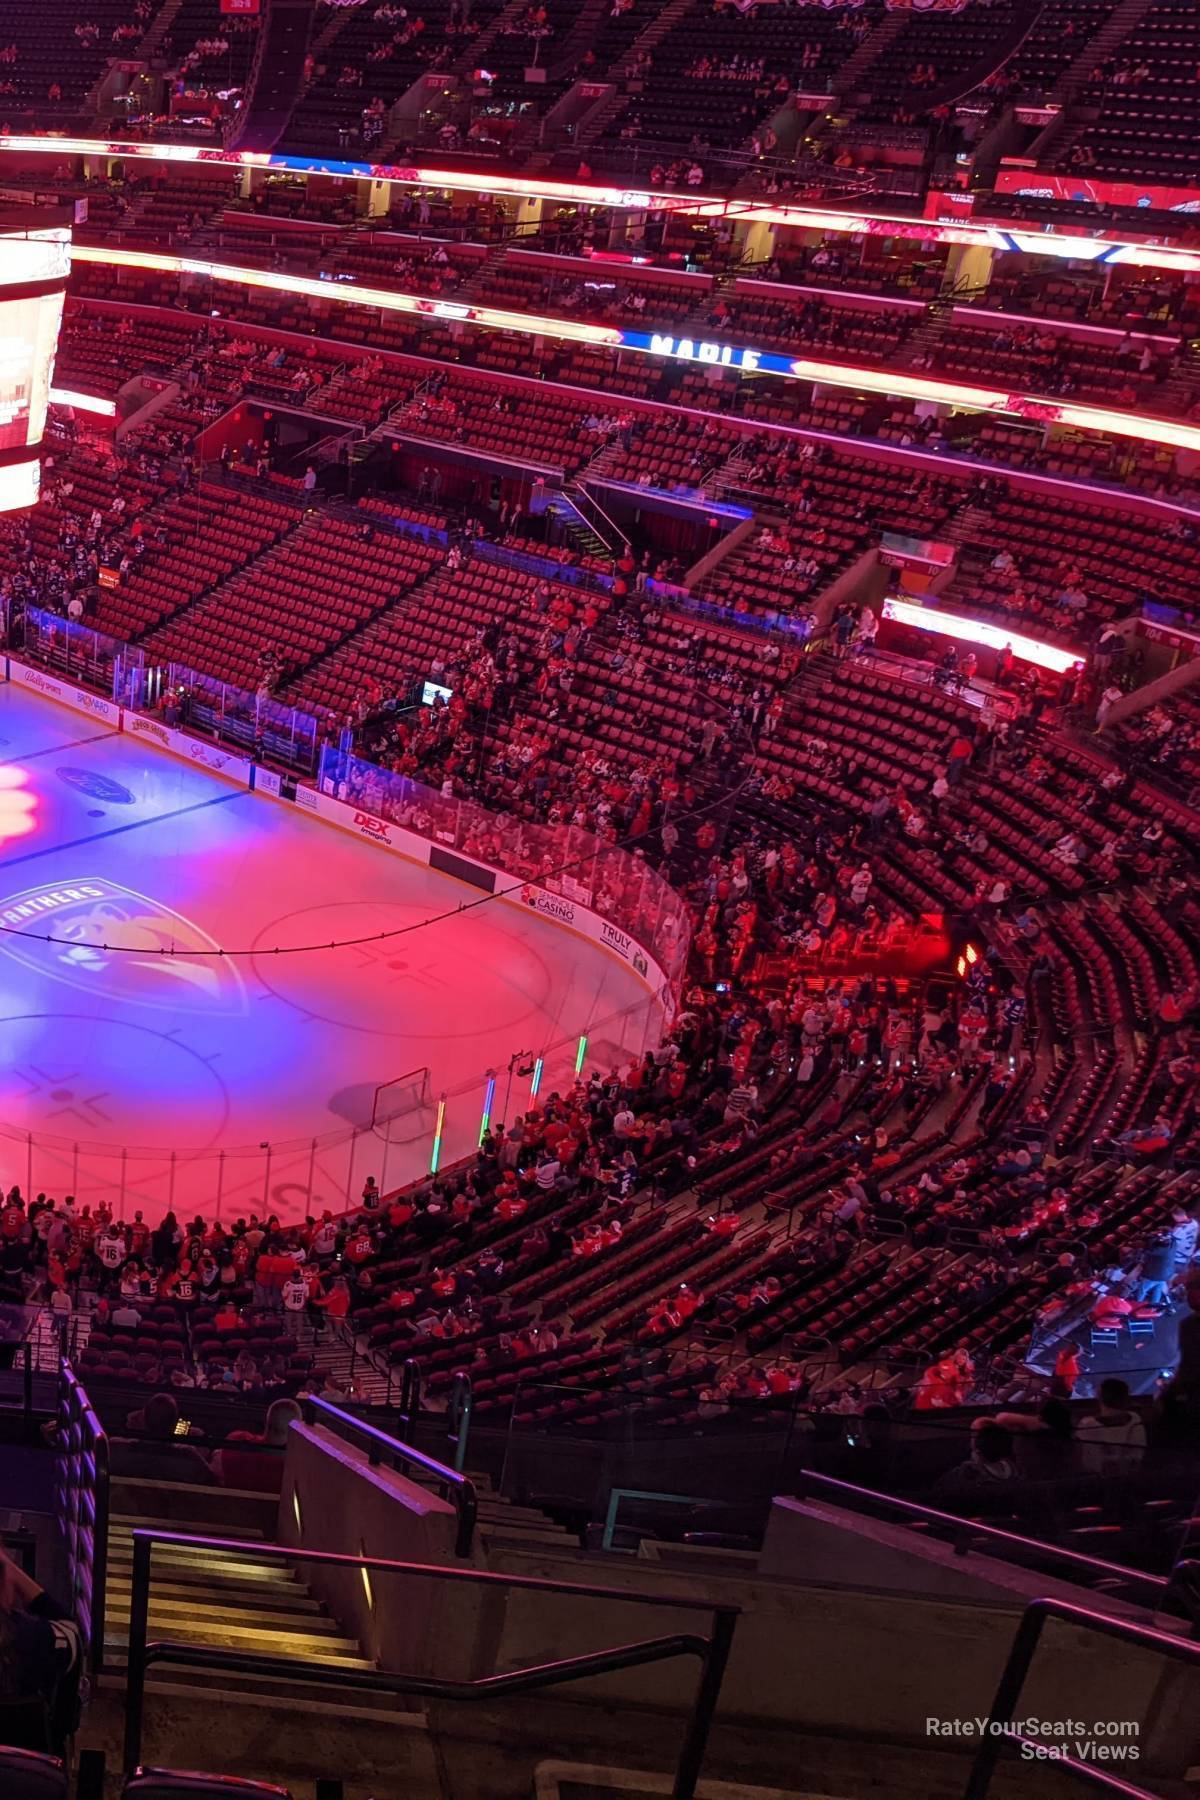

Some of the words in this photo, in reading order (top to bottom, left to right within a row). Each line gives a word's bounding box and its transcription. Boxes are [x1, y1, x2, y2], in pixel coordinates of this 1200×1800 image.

[353, 811, 392, 837] DEX
[537, 898, 574, 920] CASINO
[602, 922, 632, 950] TRULY
[8, 1214, 17, 1226] 5
[105, 1248, 117, 1260] 16
[180, 1284, 192, 1297] 16
